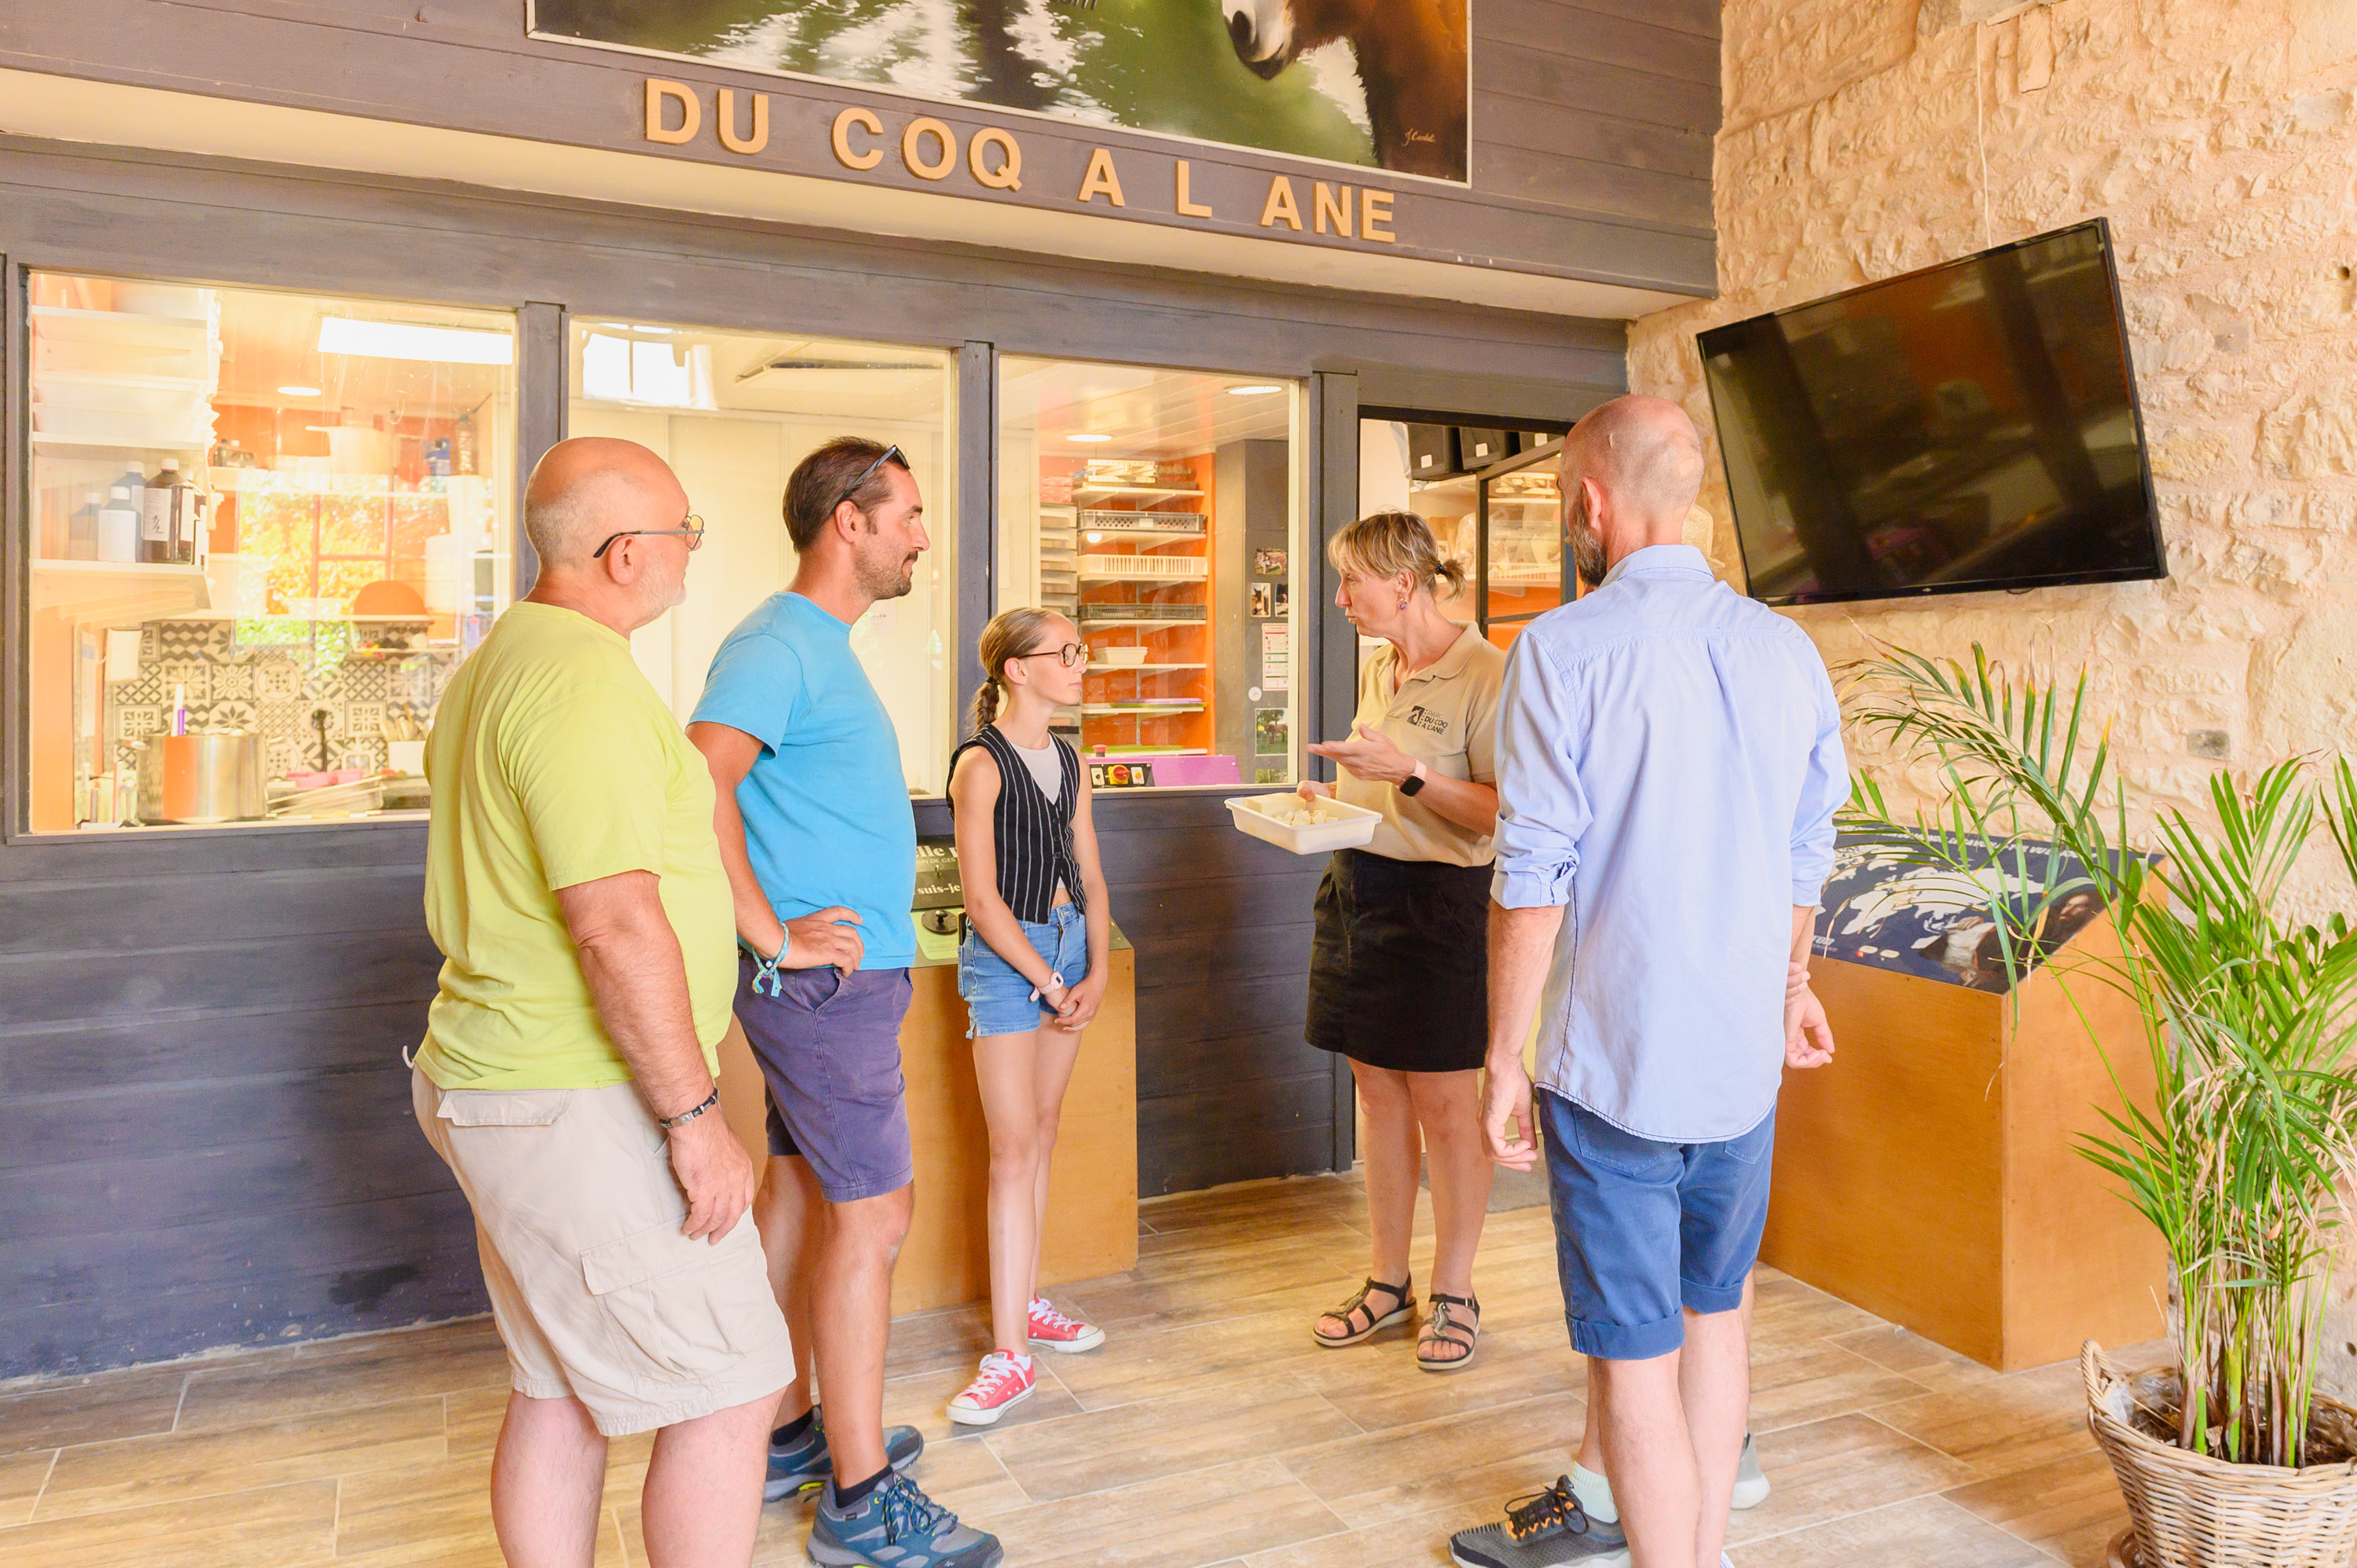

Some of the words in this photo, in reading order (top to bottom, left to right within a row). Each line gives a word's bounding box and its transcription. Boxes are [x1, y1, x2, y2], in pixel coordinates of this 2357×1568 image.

[644, 78, 769, 155] DU
[830, 107, 1023, 192] COQ
[1076, 148, 1125, 207] A
[1175, 160, 1212, 218] L
[1259, 175, 1395, 244] ANE
[1434, 719, 1448, 729] COQ
[916, 845, 945, 857] lle
